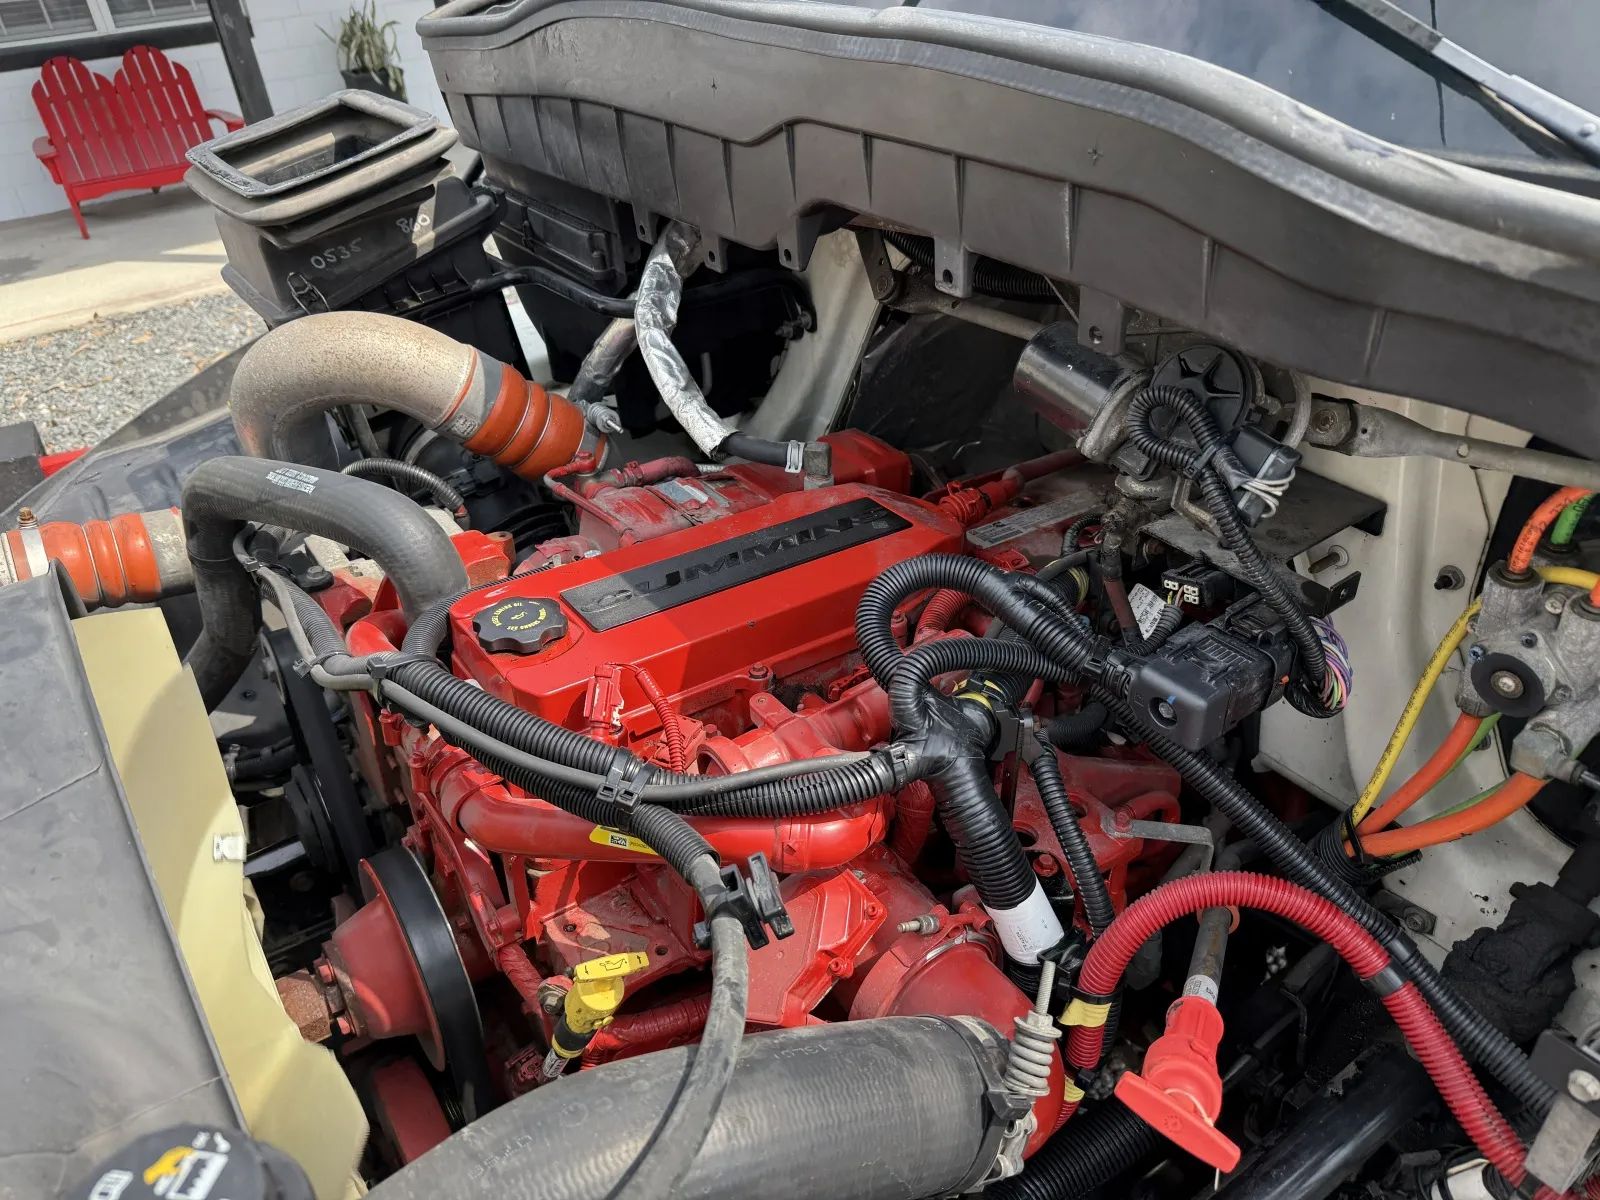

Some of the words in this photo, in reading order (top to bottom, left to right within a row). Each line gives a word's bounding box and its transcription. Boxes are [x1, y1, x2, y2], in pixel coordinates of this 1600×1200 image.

[310, 238, 362, 269] 0535
[396, 214, 431, 234] 860
[580, 506, 890, 613] CUMMINS
